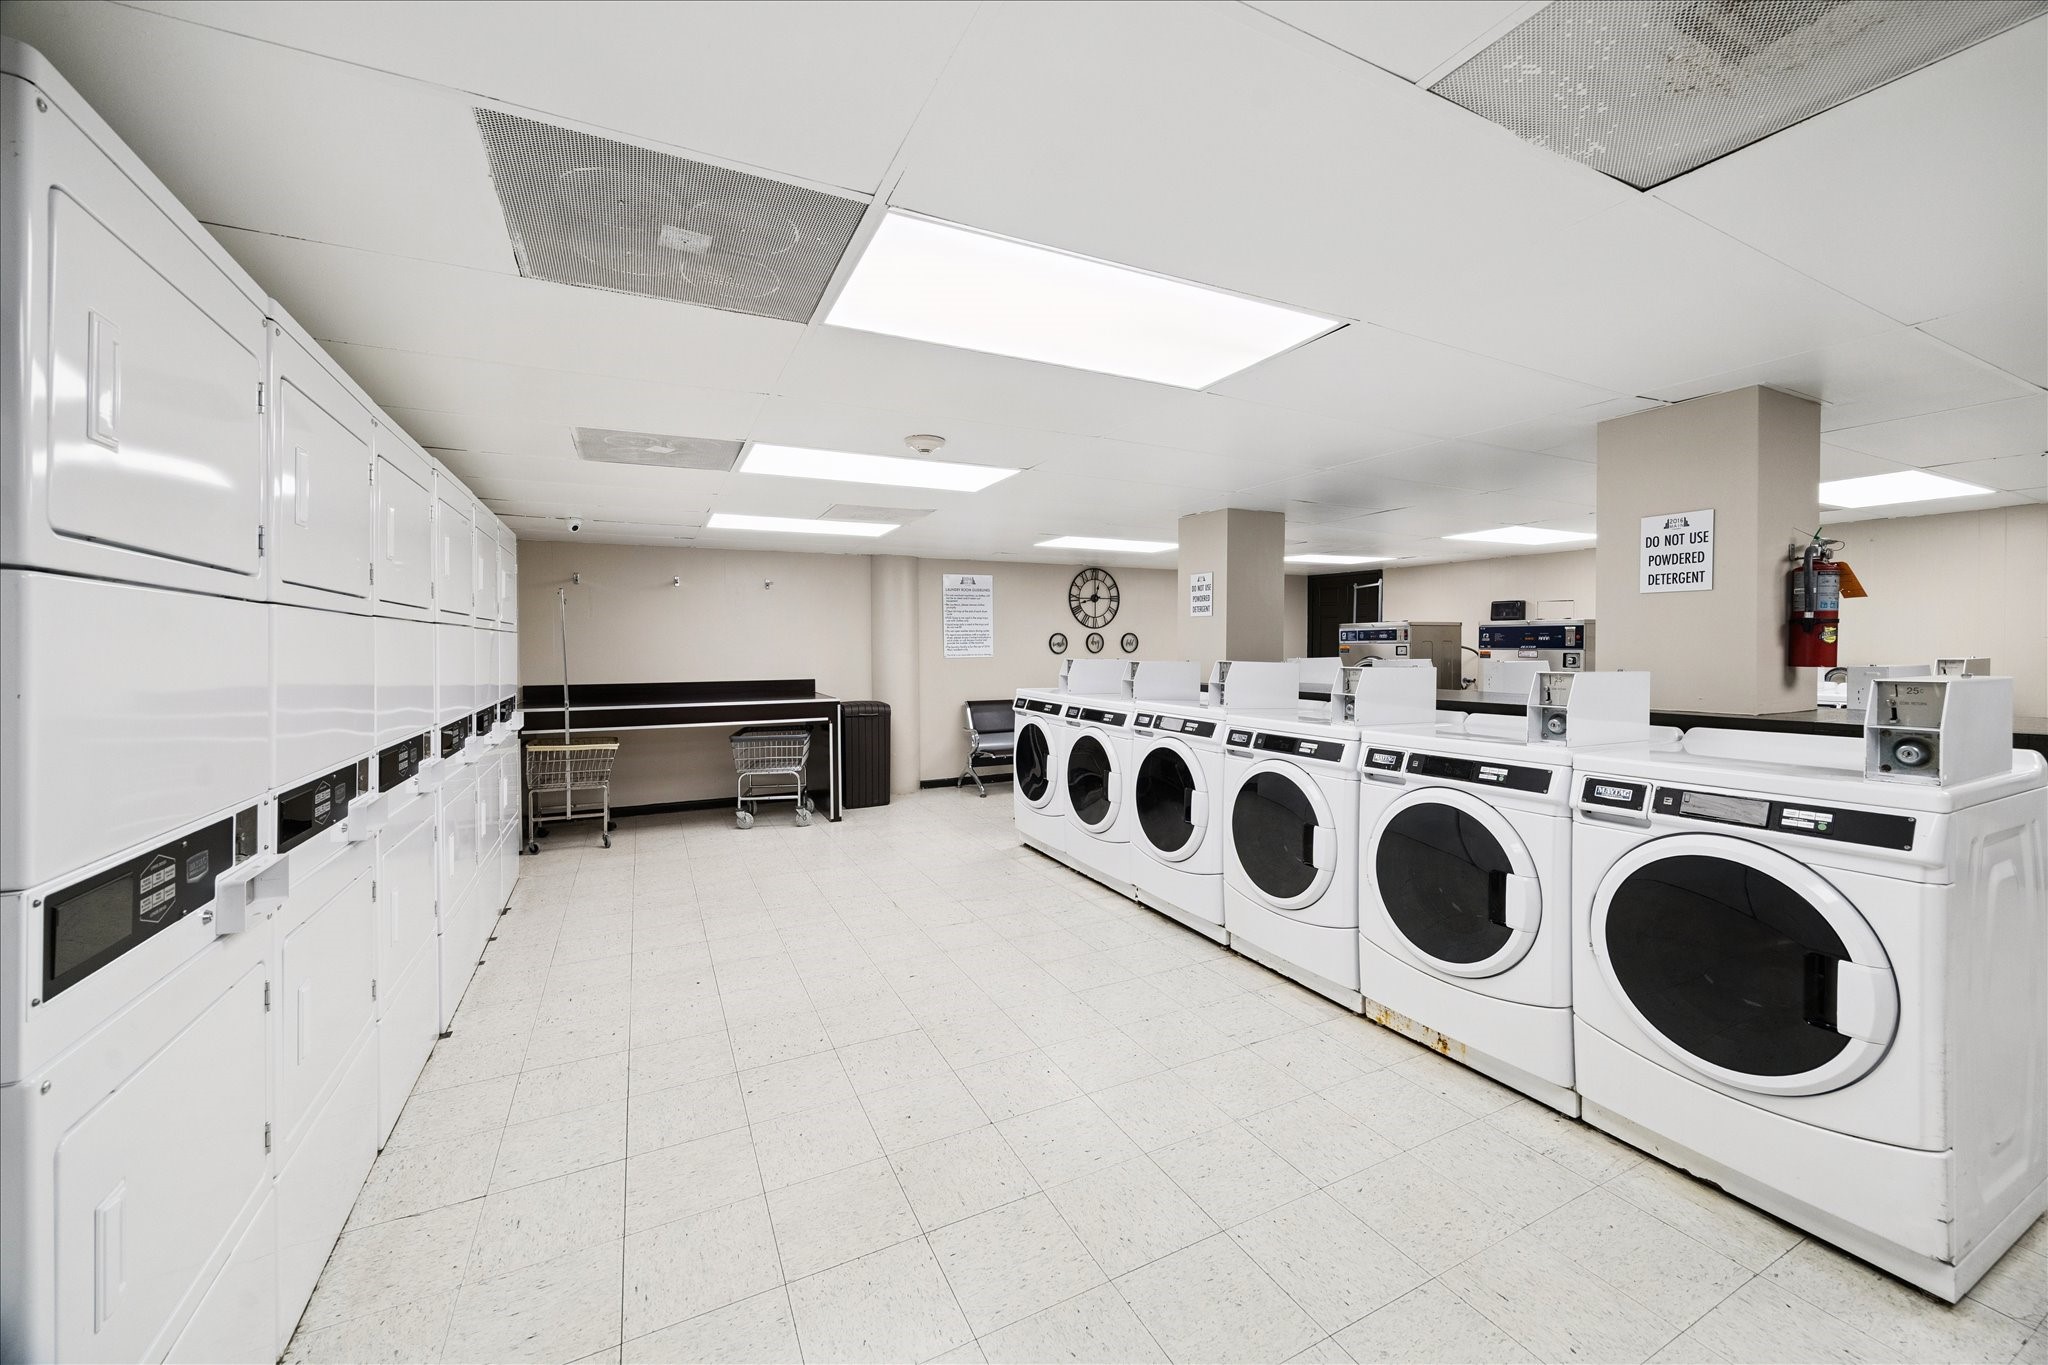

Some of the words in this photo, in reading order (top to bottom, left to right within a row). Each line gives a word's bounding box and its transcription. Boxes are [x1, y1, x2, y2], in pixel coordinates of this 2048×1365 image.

[1646, 536, 1660, 548] DO
[1665, 533, 1685, 546] NOT
[1690, 531, 1709, 544] USE
[1648, 551, 1705, 566] POWDERED
[1648, 571, 1705, 585] DETERGENT
[1596, 787, 1630, 797] MAYTAG
